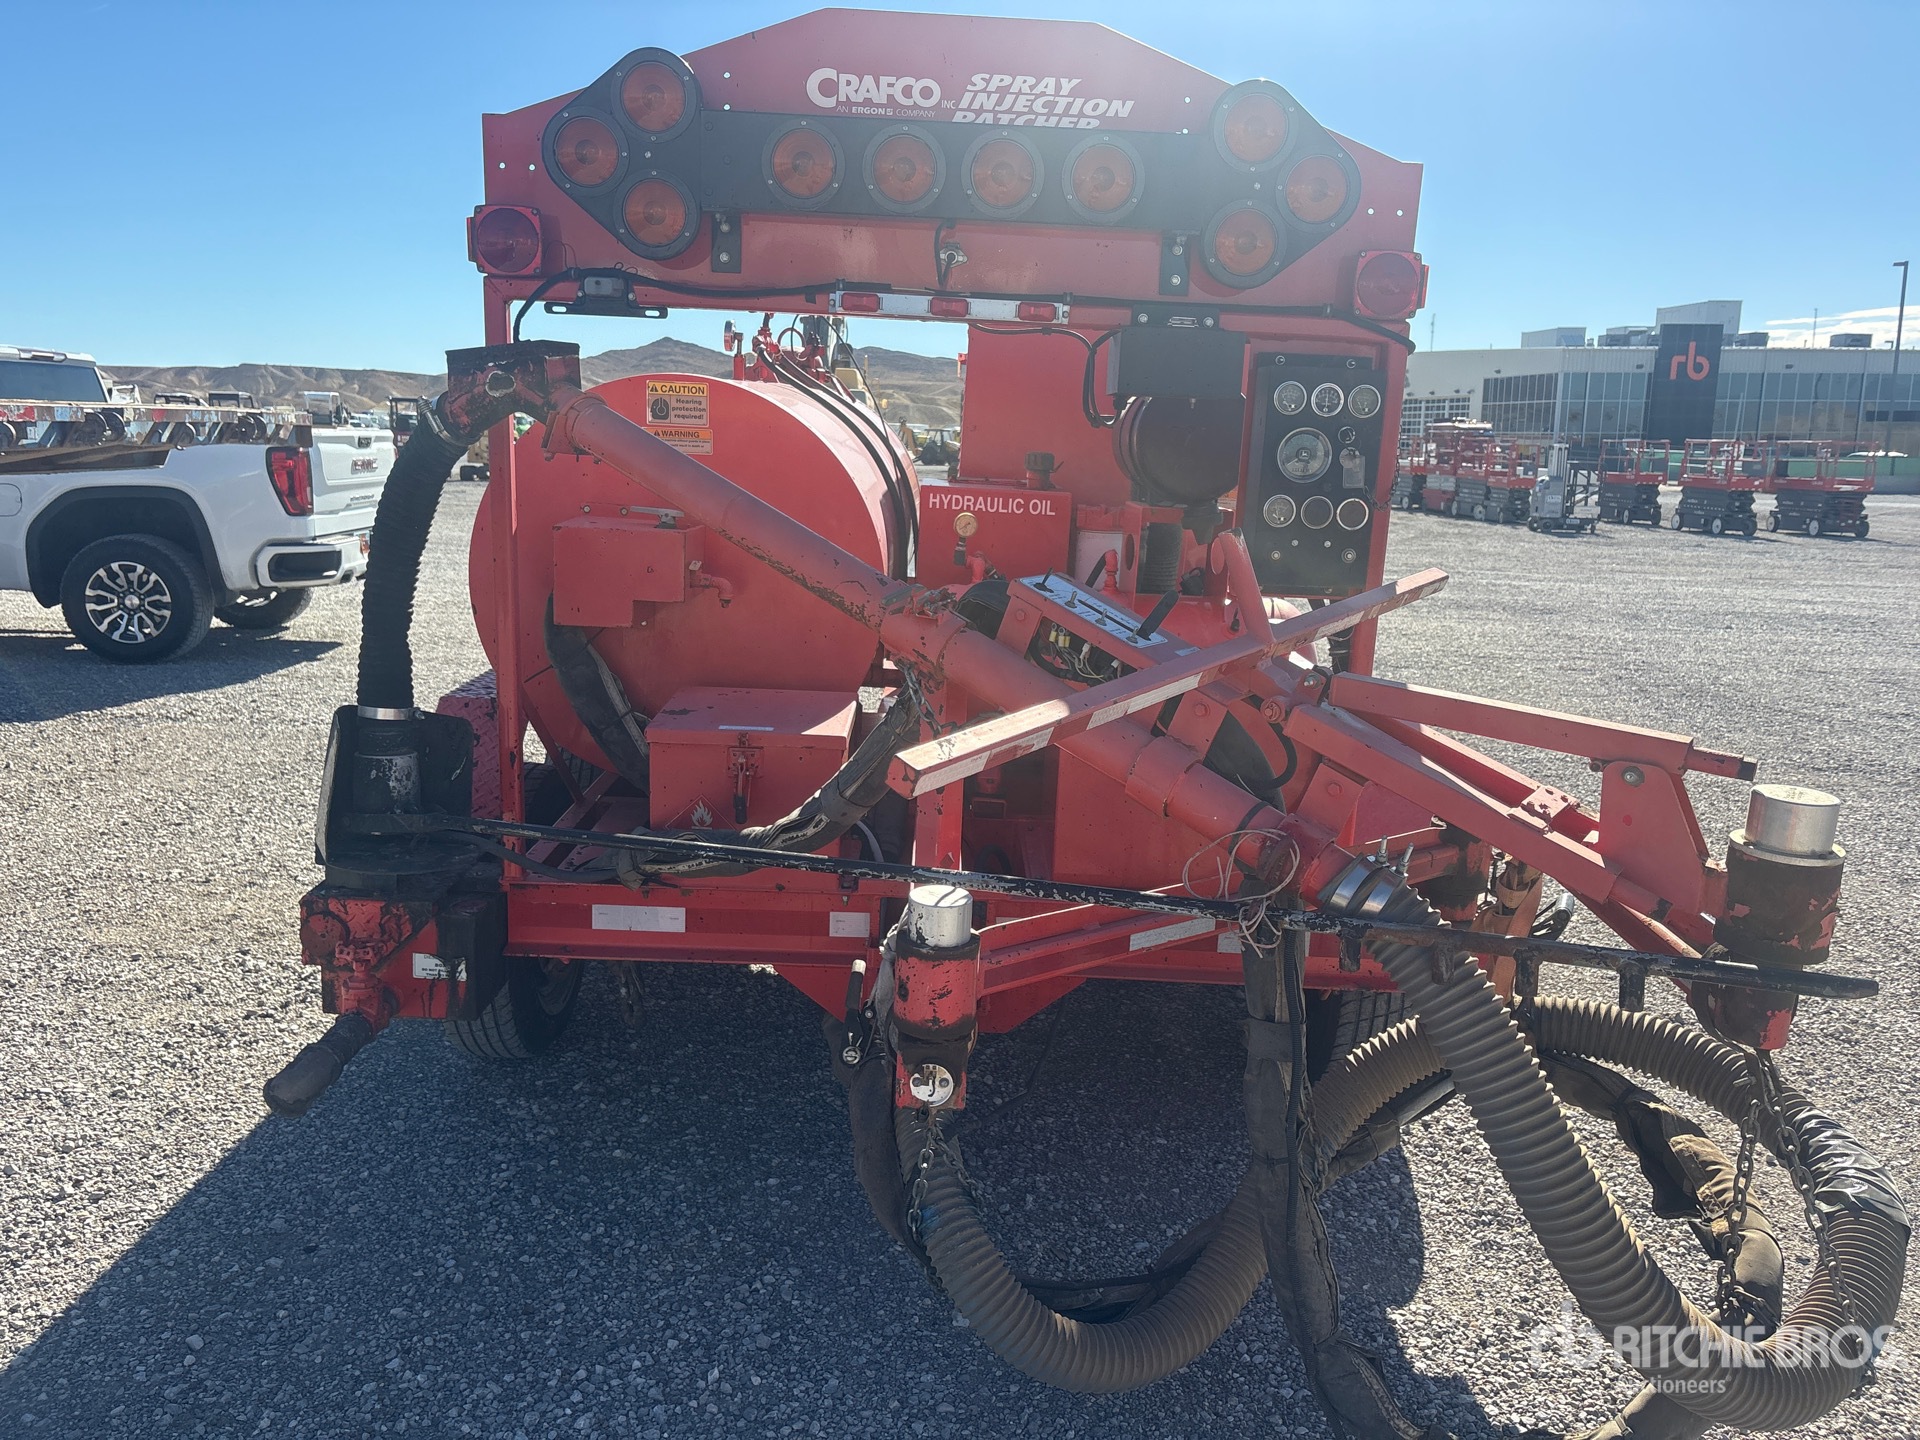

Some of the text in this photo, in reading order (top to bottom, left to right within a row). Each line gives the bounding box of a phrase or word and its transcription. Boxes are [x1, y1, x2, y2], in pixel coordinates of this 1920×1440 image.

[806, 68, 956, 109] CRAFCO INC
[966, 73, 1082, 95] SPRAY
[836, 105, 936, 118] AN ERGON COMPANY
[958, 92, 1135, 117] INJECTION
[1669, 341, 1710, 381] rb
[660, 384, 705, 394] CAUTION
[661, 430, 700, 438] WARNING
[929, 493, 1056, 516] HYDRAULIC OIL
